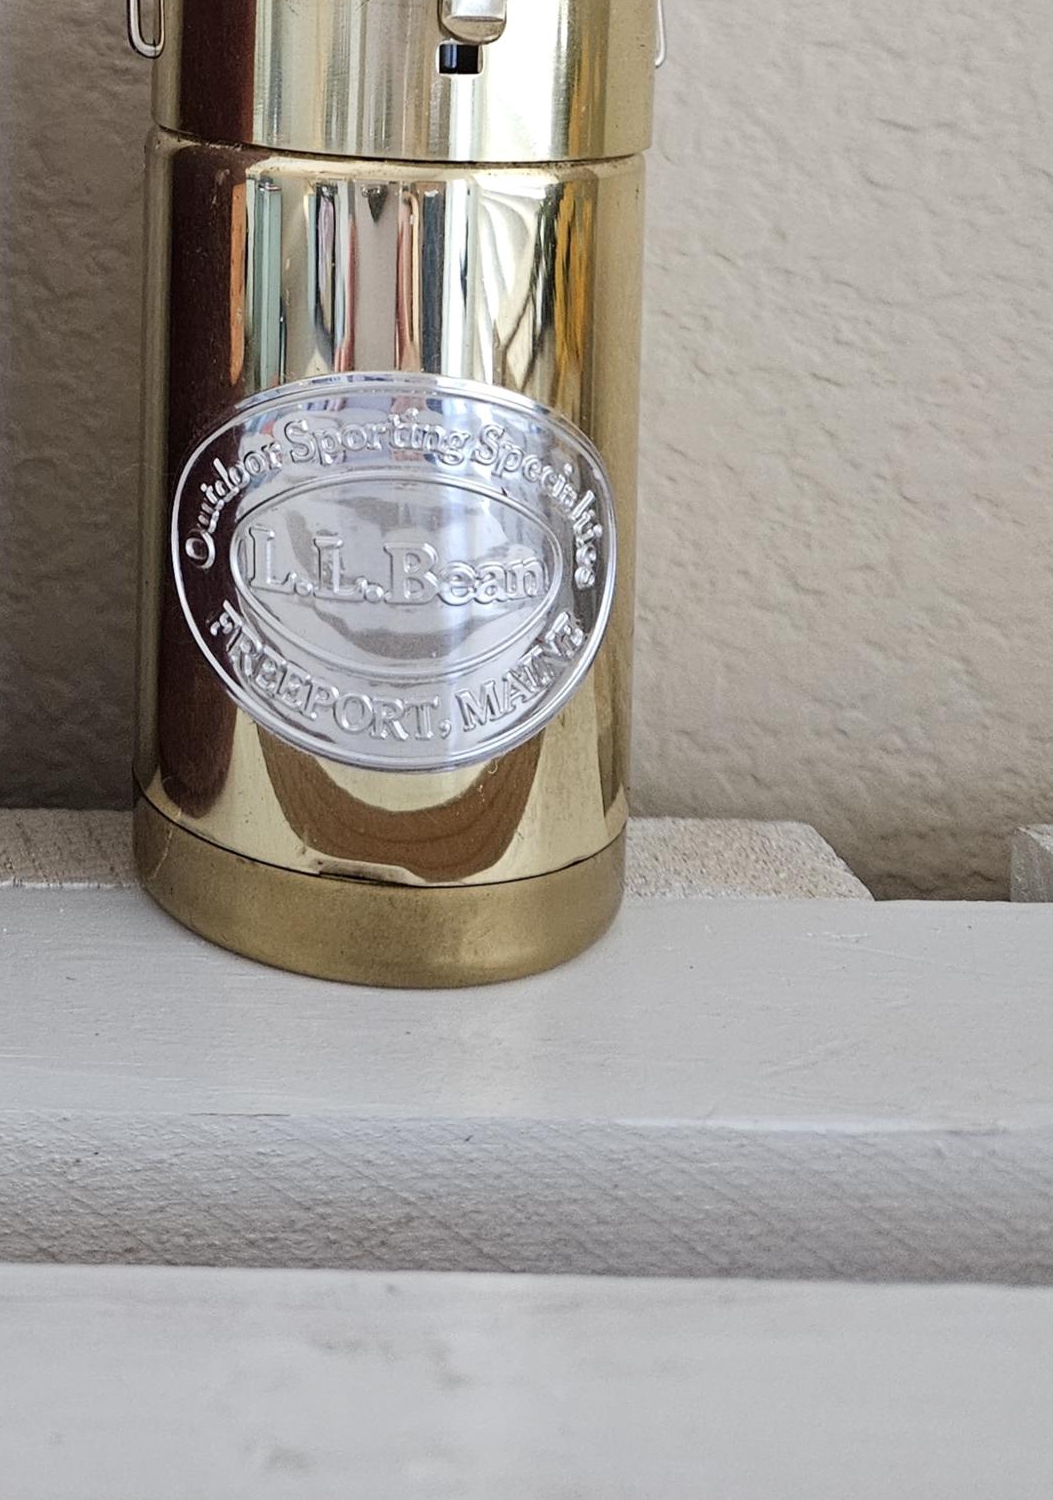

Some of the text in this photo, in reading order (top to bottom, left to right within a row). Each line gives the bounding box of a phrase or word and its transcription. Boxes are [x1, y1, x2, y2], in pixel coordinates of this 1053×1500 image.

[185, 441, 283, 569] Outdoor
[284, 409, 470, 465] Sporting
[455, 611, 586, 732] MAINE
